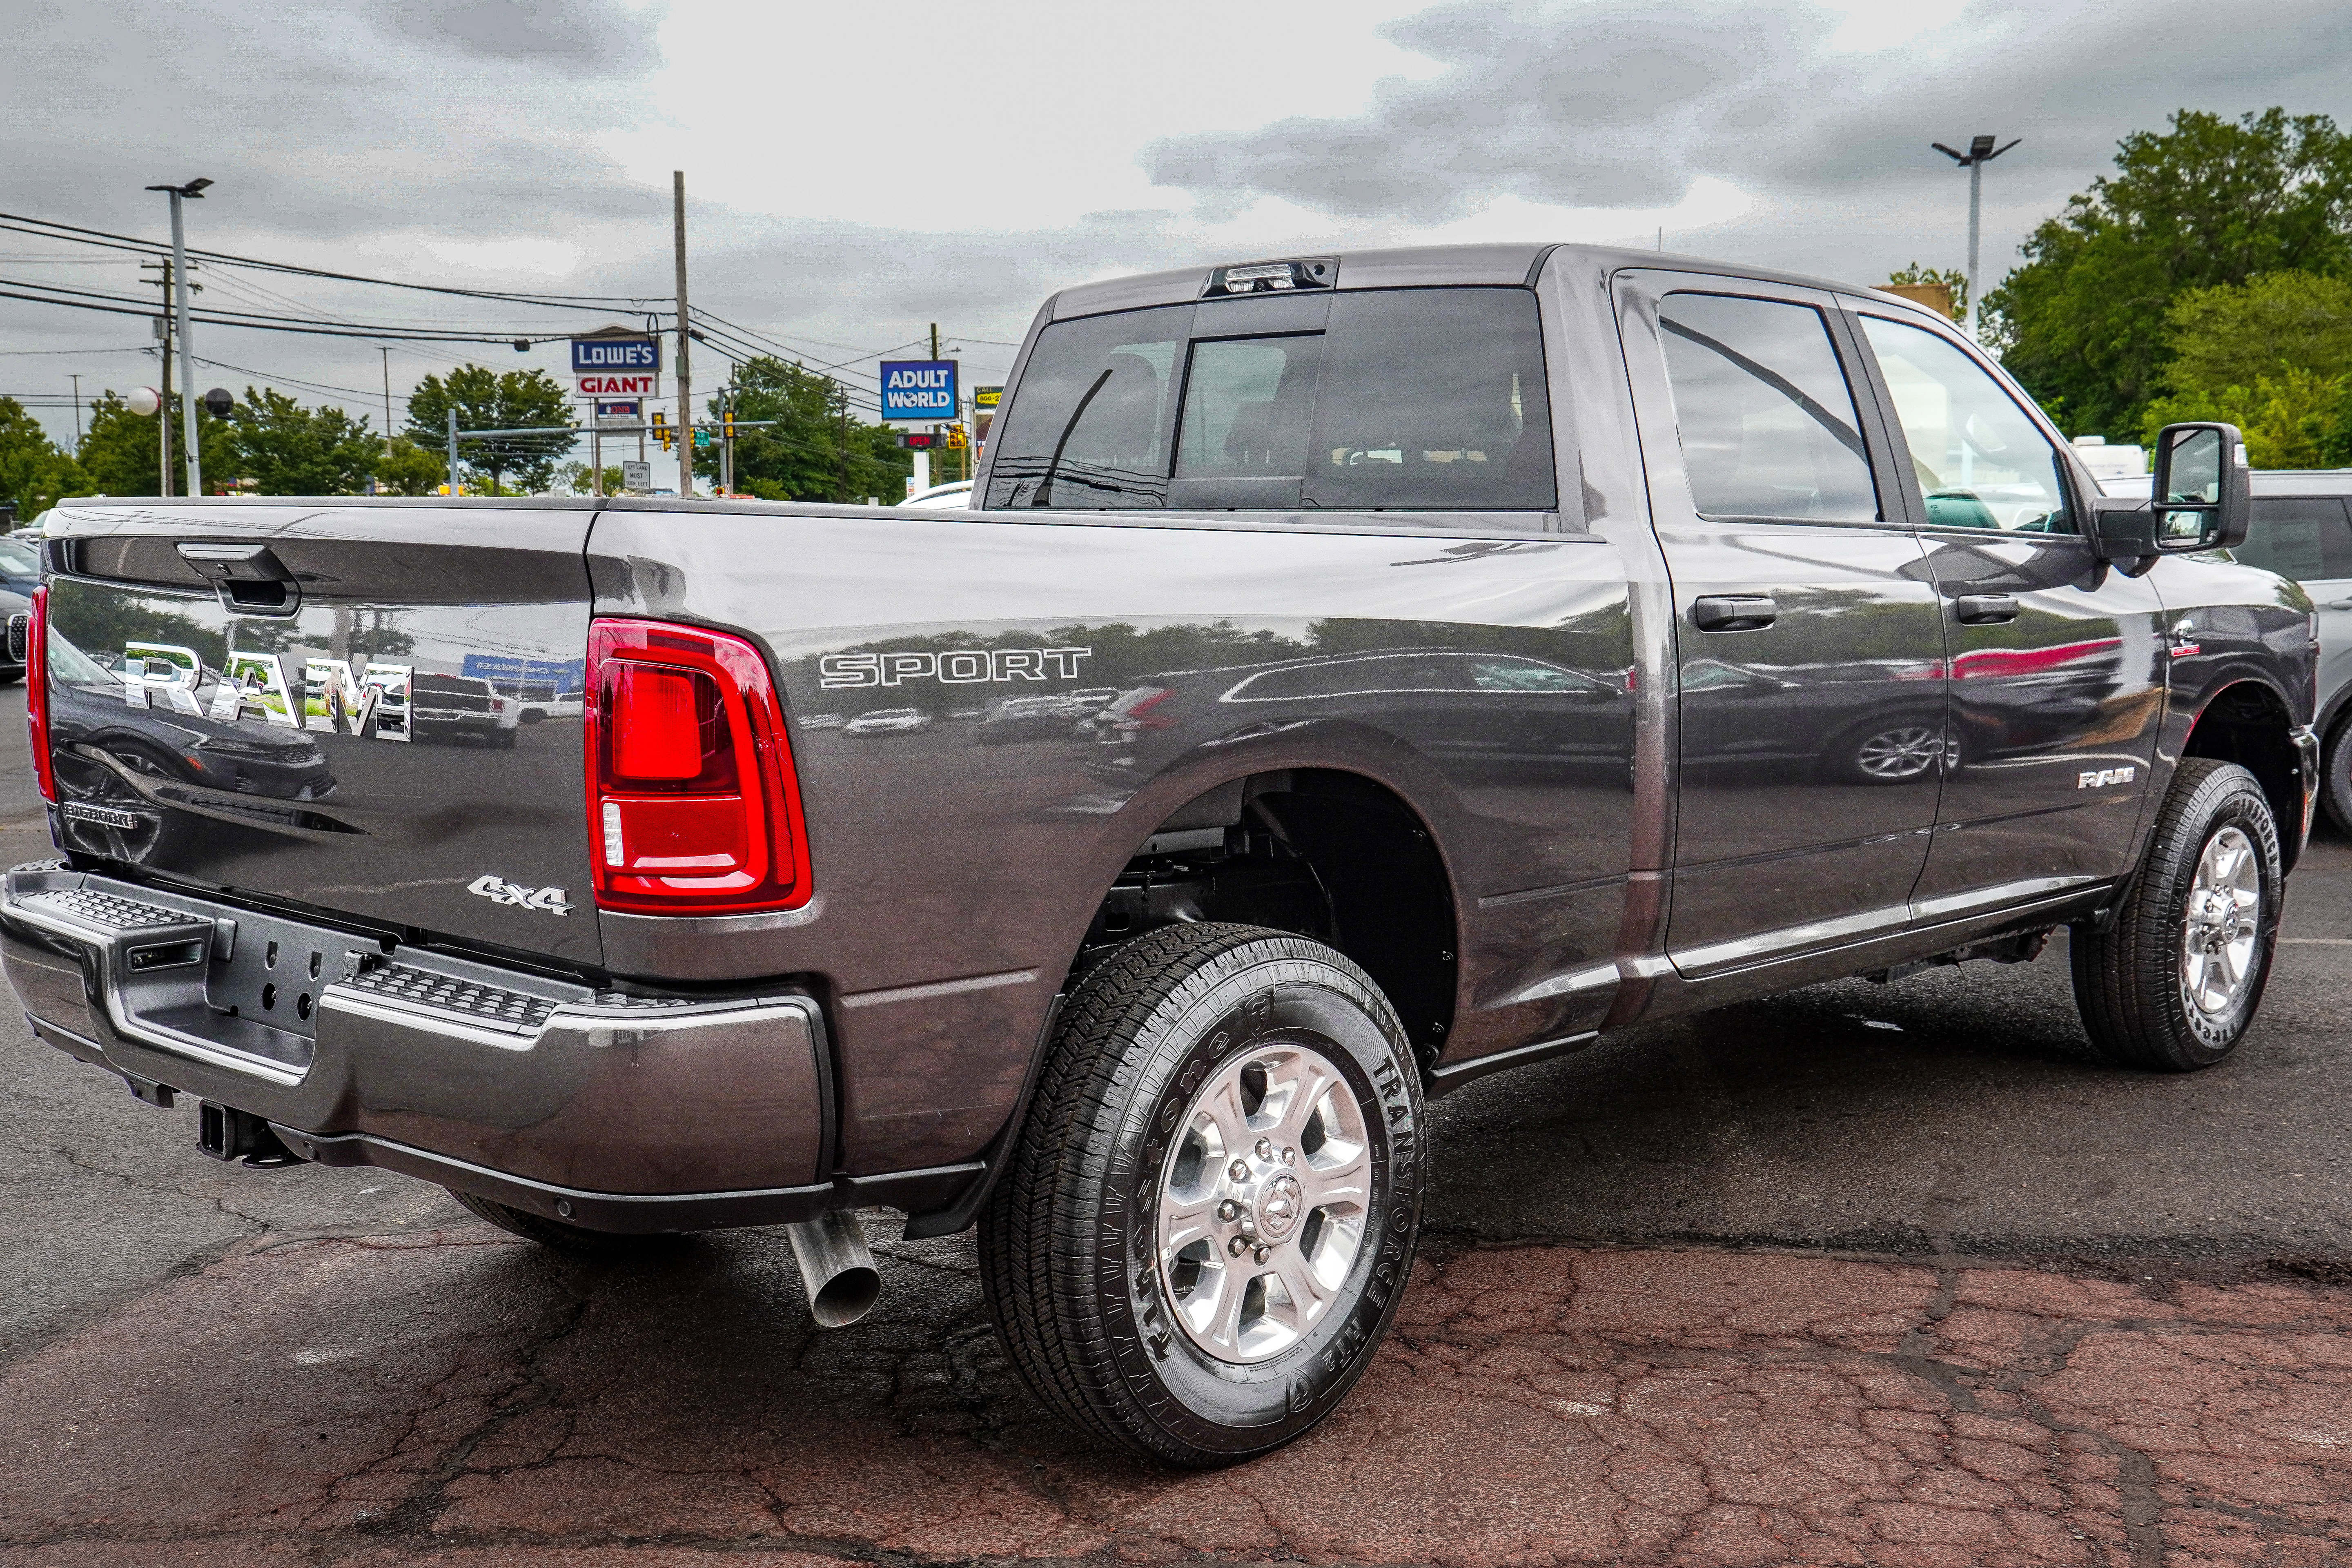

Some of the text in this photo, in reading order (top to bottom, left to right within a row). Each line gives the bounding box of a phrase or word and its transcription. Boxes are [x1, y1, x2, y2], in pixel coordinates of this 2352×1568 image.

[579, 344, 653, 364] LOWE'S
[580, 376, 653, 392] GIANT
[888, 370, 949, 388] ADULT
[888, 391, 950, 408] WORLD
[611, 405, 630, 414] QNB
[909, 436, 930, 445] OPEN
[820, 646, 1092, 689] SPORT
[126, 641, 414, 742] RAM
[2078, 767, 2134, 789] RAM
[1366, 1055, 1414, 1309] TRANSFORCE
